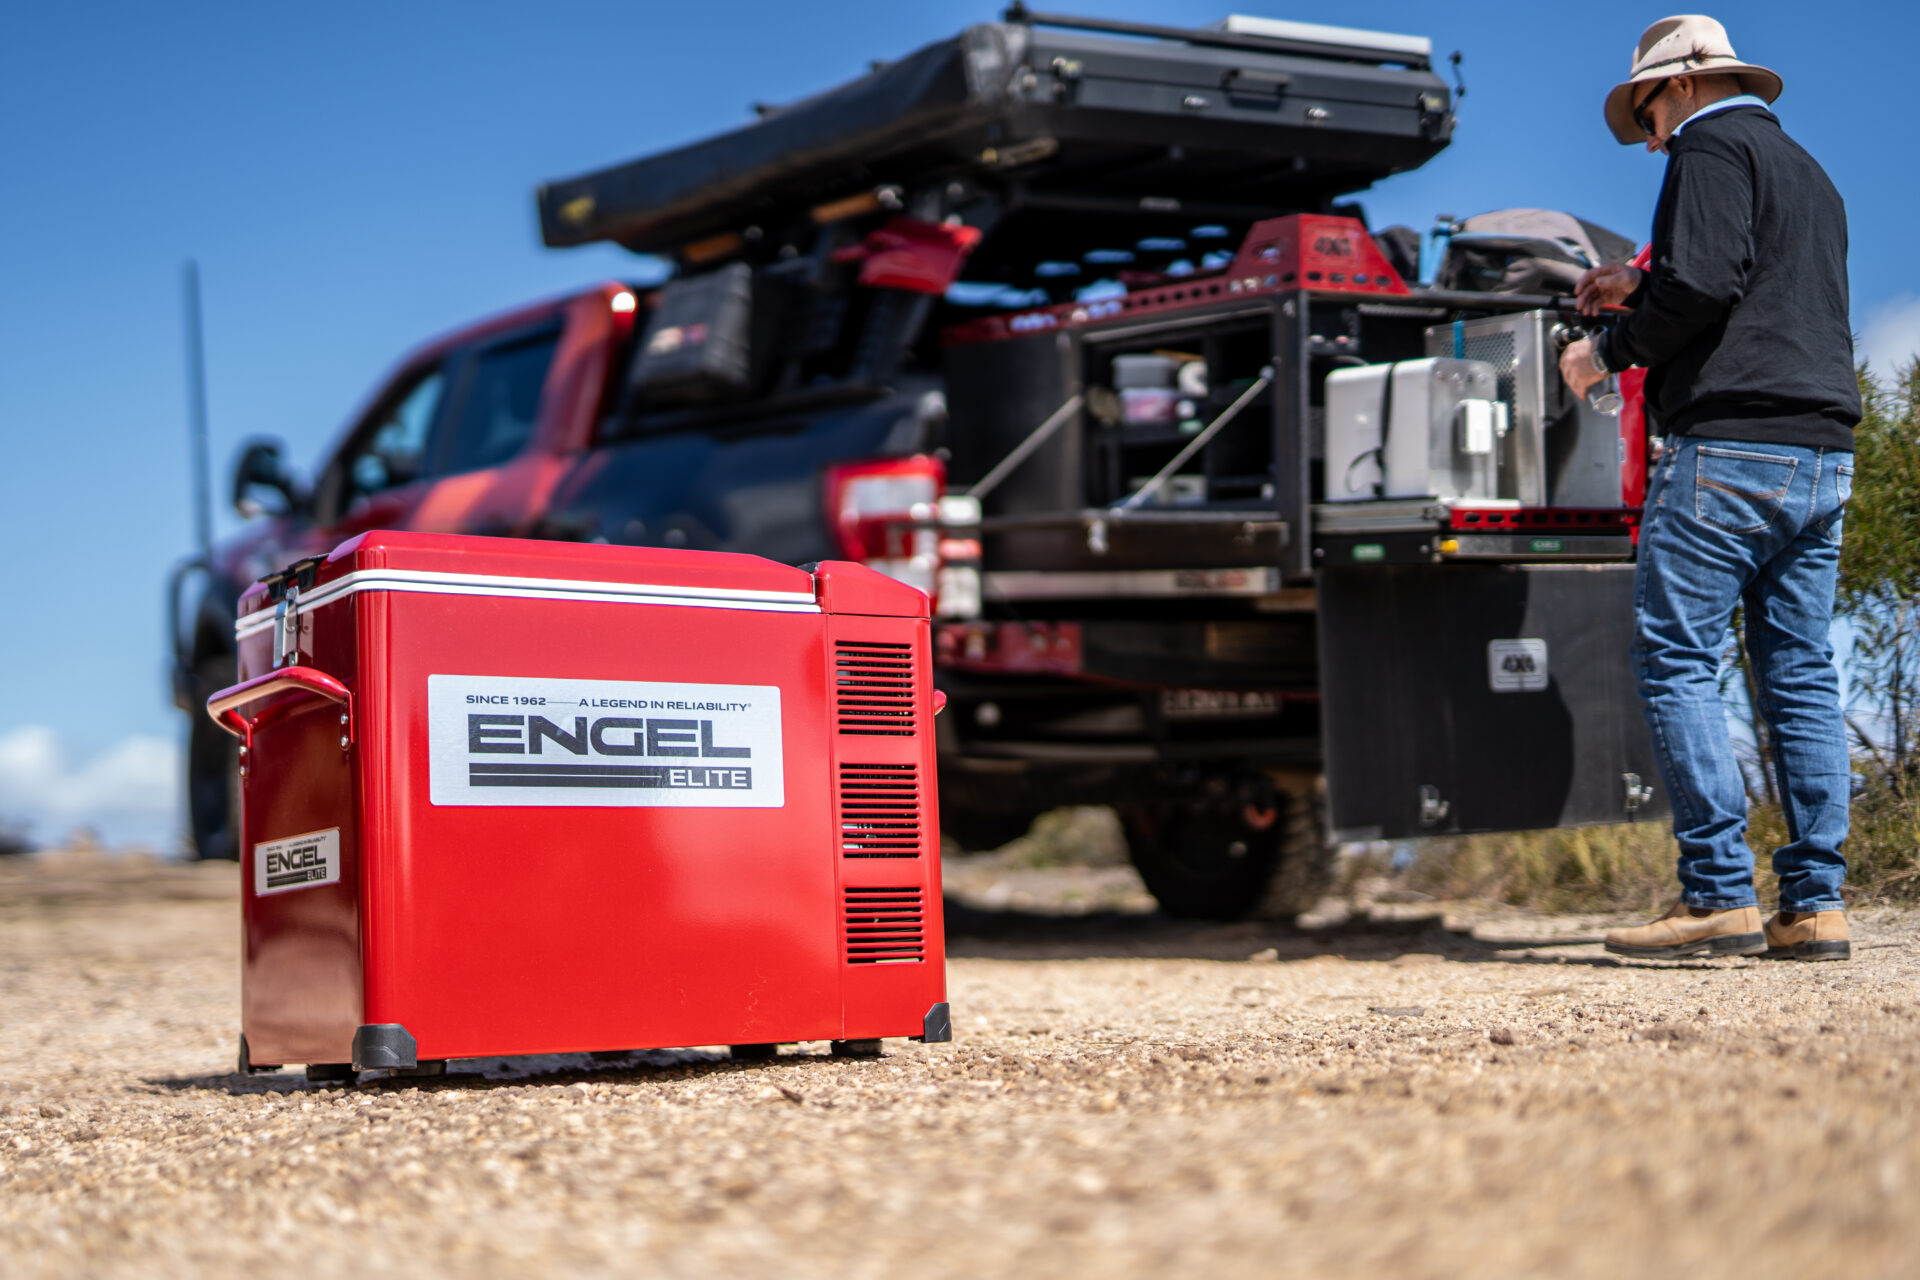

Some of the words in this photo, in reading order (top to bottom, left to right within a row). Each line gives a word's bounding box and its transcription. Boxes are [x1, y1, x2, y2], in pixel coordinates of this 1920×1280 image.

[466, 694, 509, 705] SINCE
[513, 696, 547, 706] 1962
[578, 698, 589, 707] A
[592, 699, 648, 709] LEGEND
[650, 700, 664, 709] IN
[468, 714, 751, 758] ENGEL
[669, 768, 748, 787] ELITE
[266, 845, 327, 874] ENGEL
[307, 868, 326, 881] ELITE
